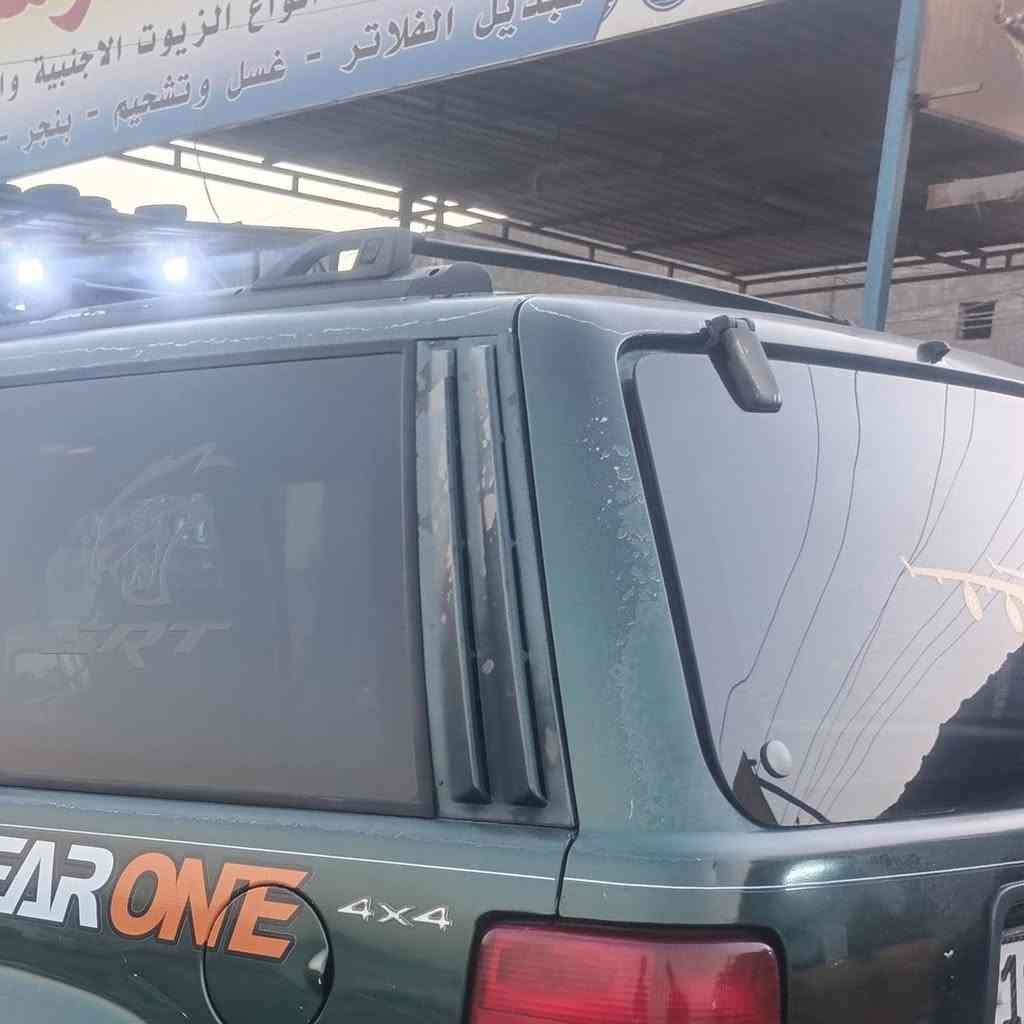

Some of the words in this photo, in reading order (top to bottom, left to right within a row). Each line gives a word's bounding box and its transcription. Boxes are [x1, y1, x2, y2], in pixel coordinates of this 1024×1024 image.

[137, 3, 232, 57] الزيوت
[340, 3, 455, 73] الفلاتر
[226, 50, 288, 101] غسل
